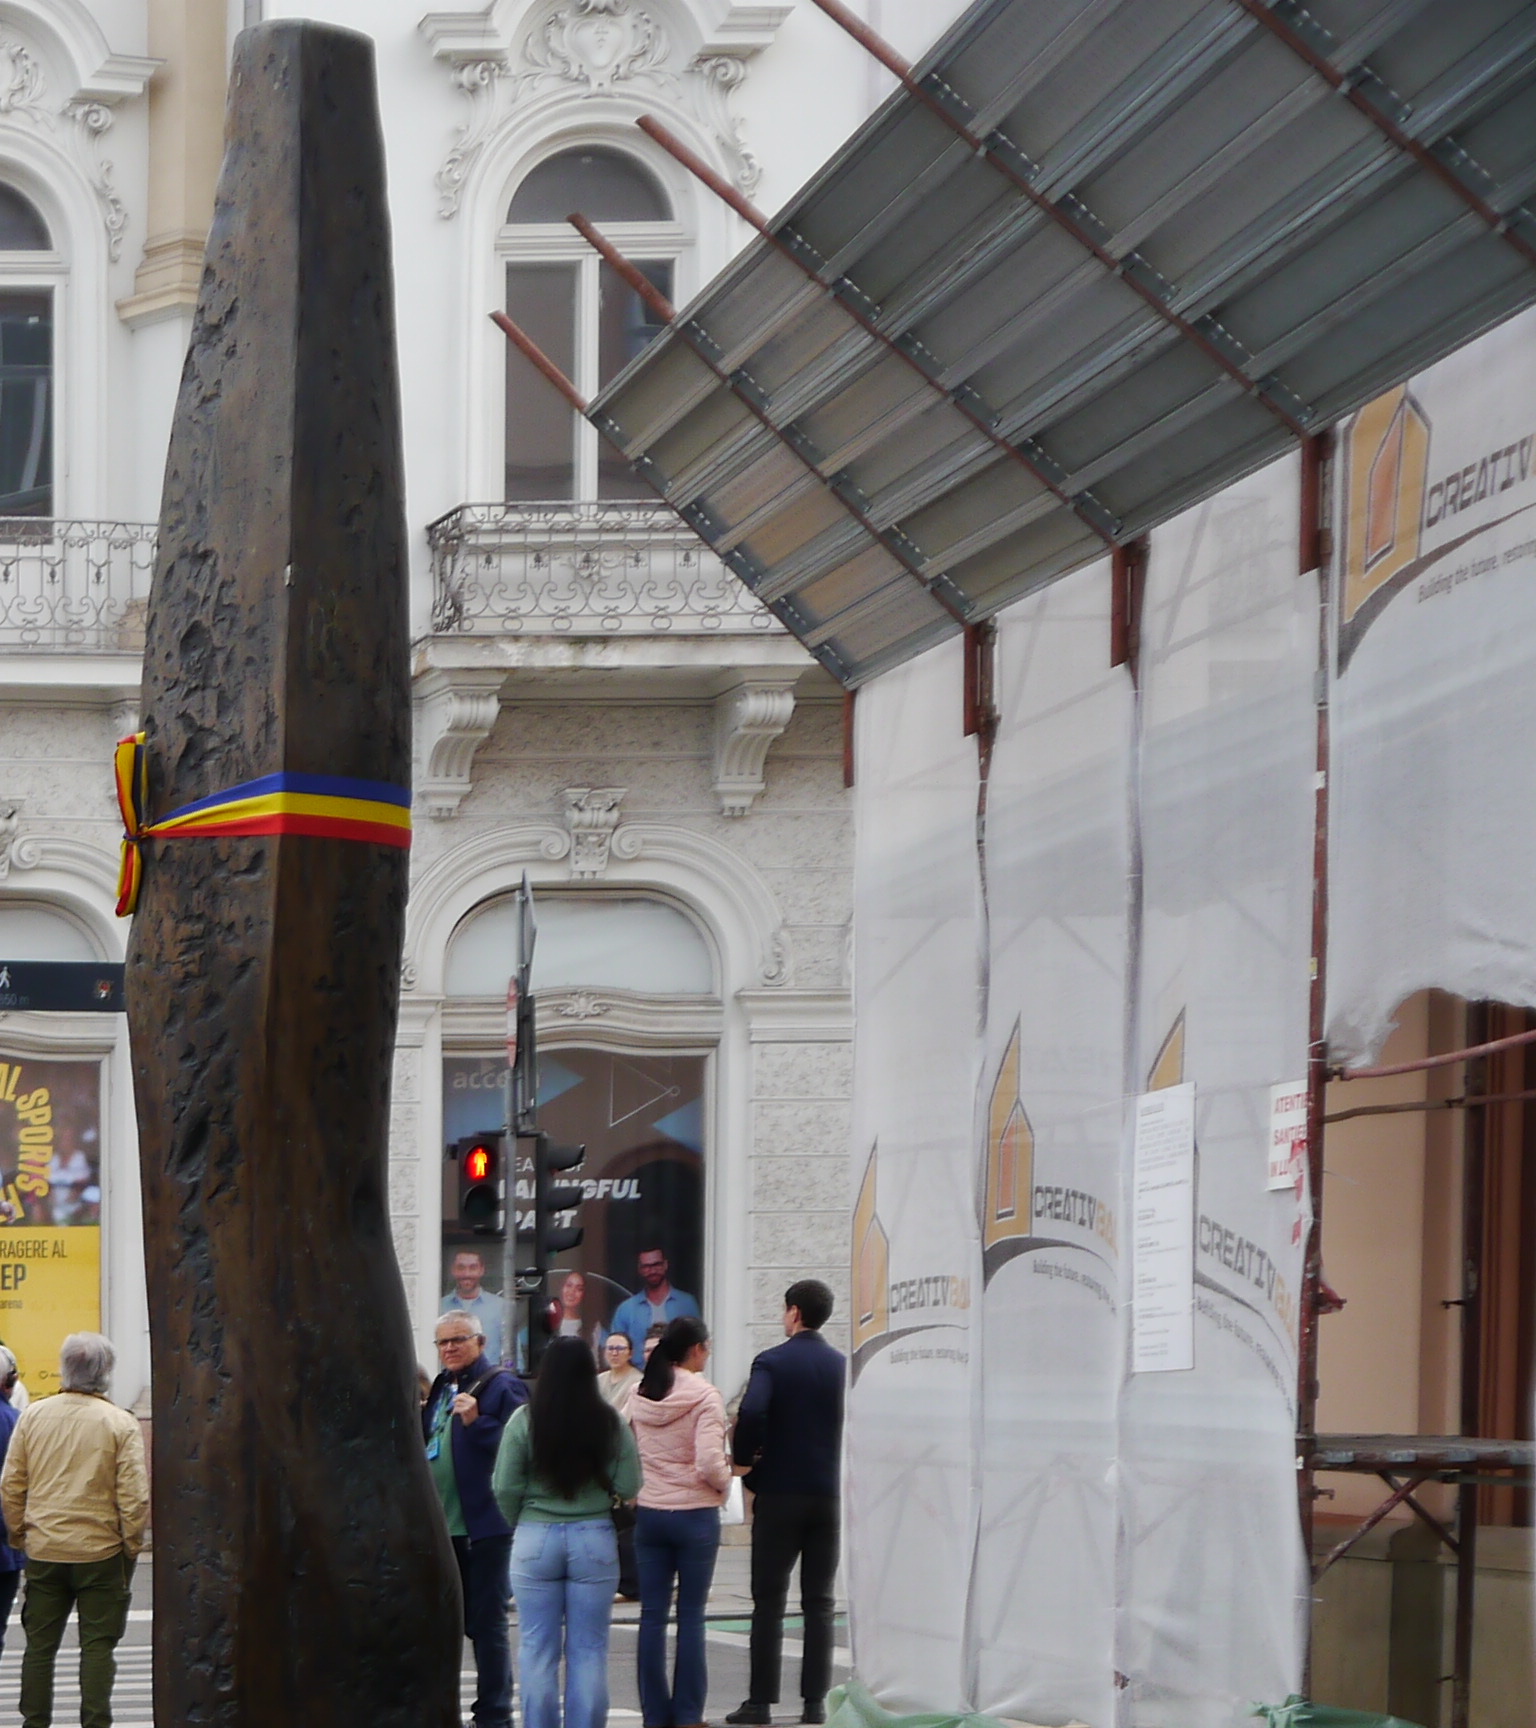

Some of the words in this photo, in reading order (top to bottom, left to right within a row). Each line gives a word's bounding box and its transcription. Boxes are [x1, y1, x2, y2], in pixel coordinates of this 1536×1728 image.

[1426, 434, 1536, 529] CREATIV
[15, 1087, 54, 1198] SPORTS
[52, 1239, 68, 1259] AL
